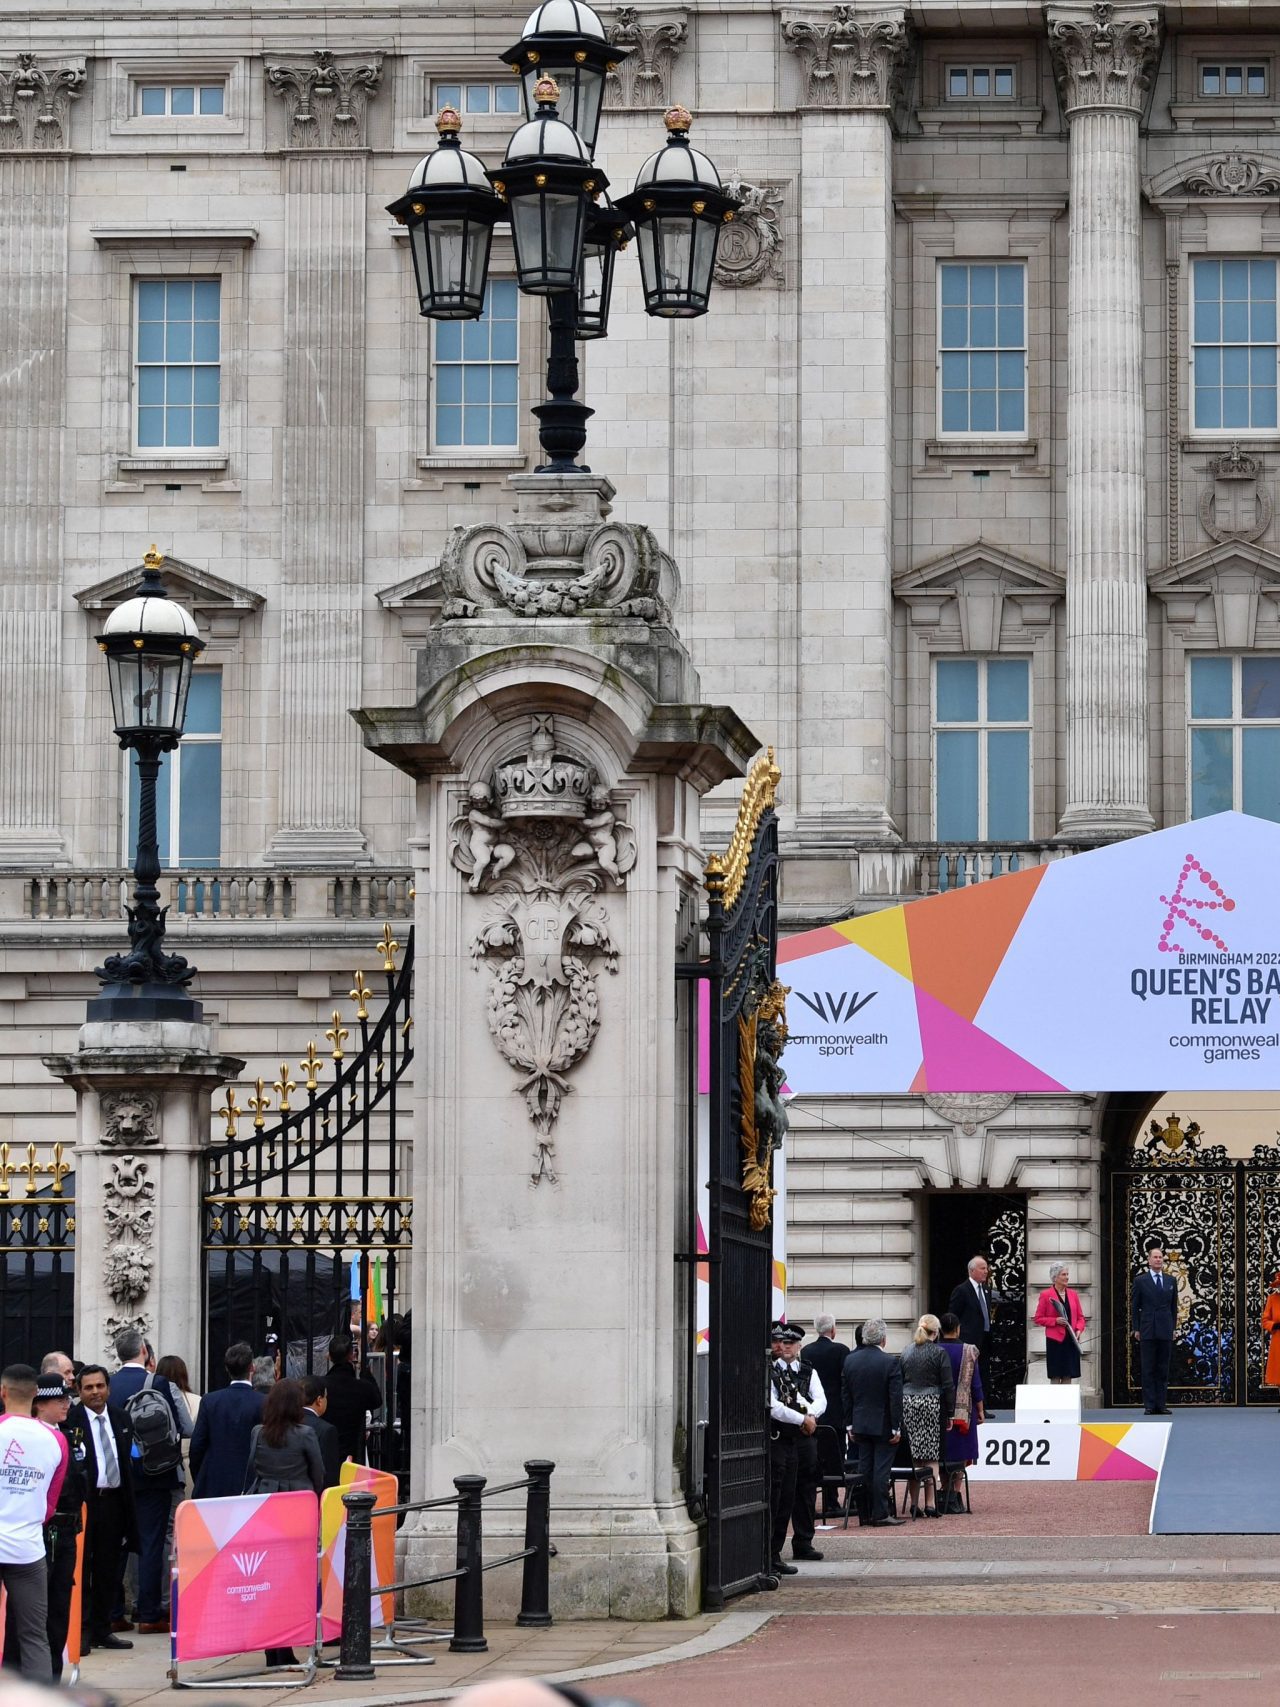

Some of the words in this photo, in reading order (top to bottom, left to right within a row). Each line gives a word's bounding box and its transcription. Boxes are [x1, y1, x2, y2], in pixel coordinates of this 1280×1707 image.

[1178, 953, 1254, 965] BIRMINGHAM
[1131, 968, 1241, 1001] QUEEN'S
[1191, 998, 1272, 1024] RELAY
[819, 1044, 854, 1057] sport
[1203, 1048, 1261, 1064] games
[985, 1439, 1050, 1465] 2022
[0, 1467, 24, 1478] UEEN'S
[24, 1470, 46, 1480] BATON
[8, 1476, 30, 1486] RELAY
